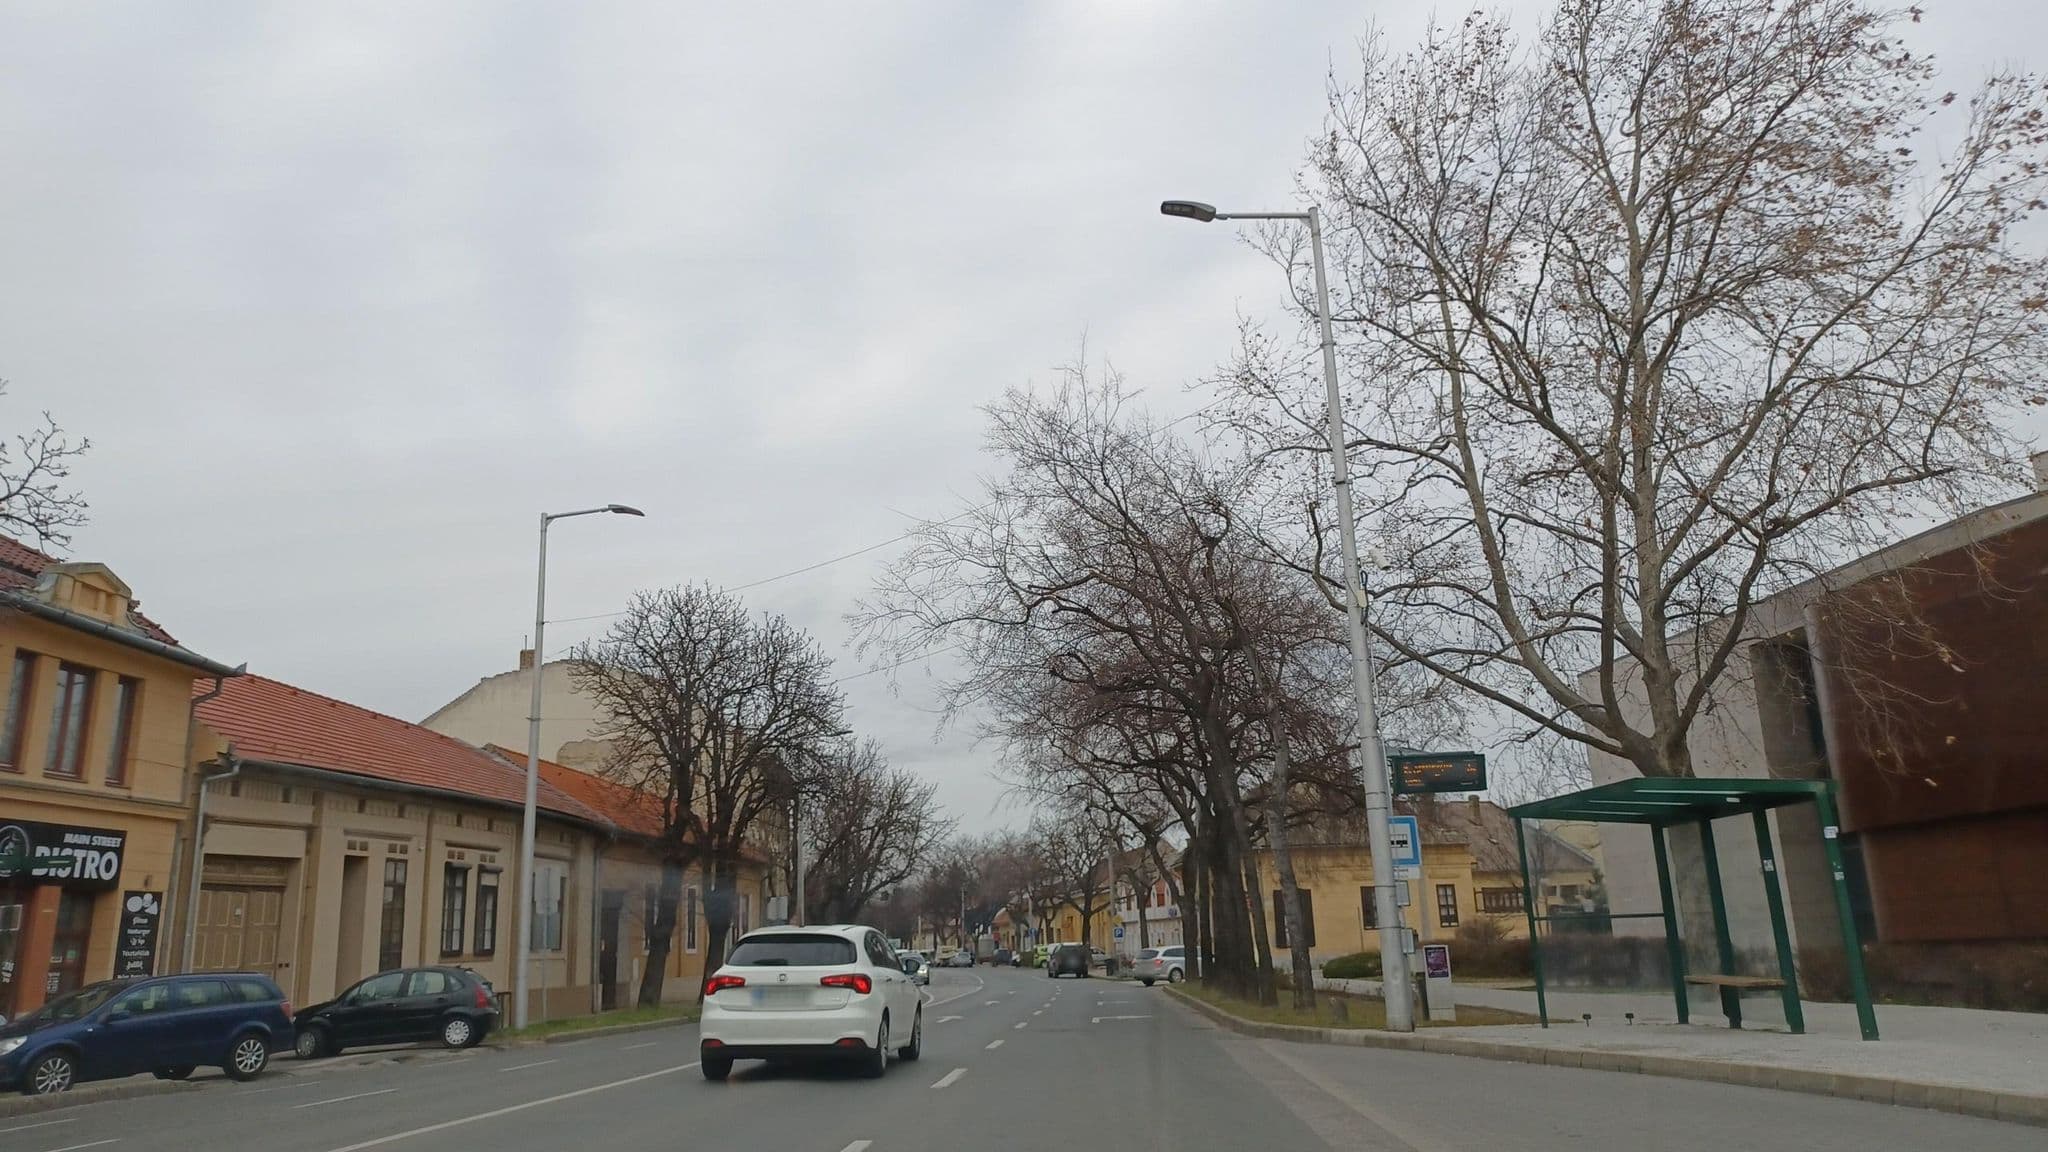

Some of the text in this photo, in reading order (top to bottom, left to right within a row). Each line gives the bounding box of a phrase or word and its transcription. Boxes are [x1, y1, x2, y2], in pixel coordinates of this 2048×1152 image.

[64, 833, 122, 848] MAIN STREET
[32, 846, 118, 880] BISTRO
